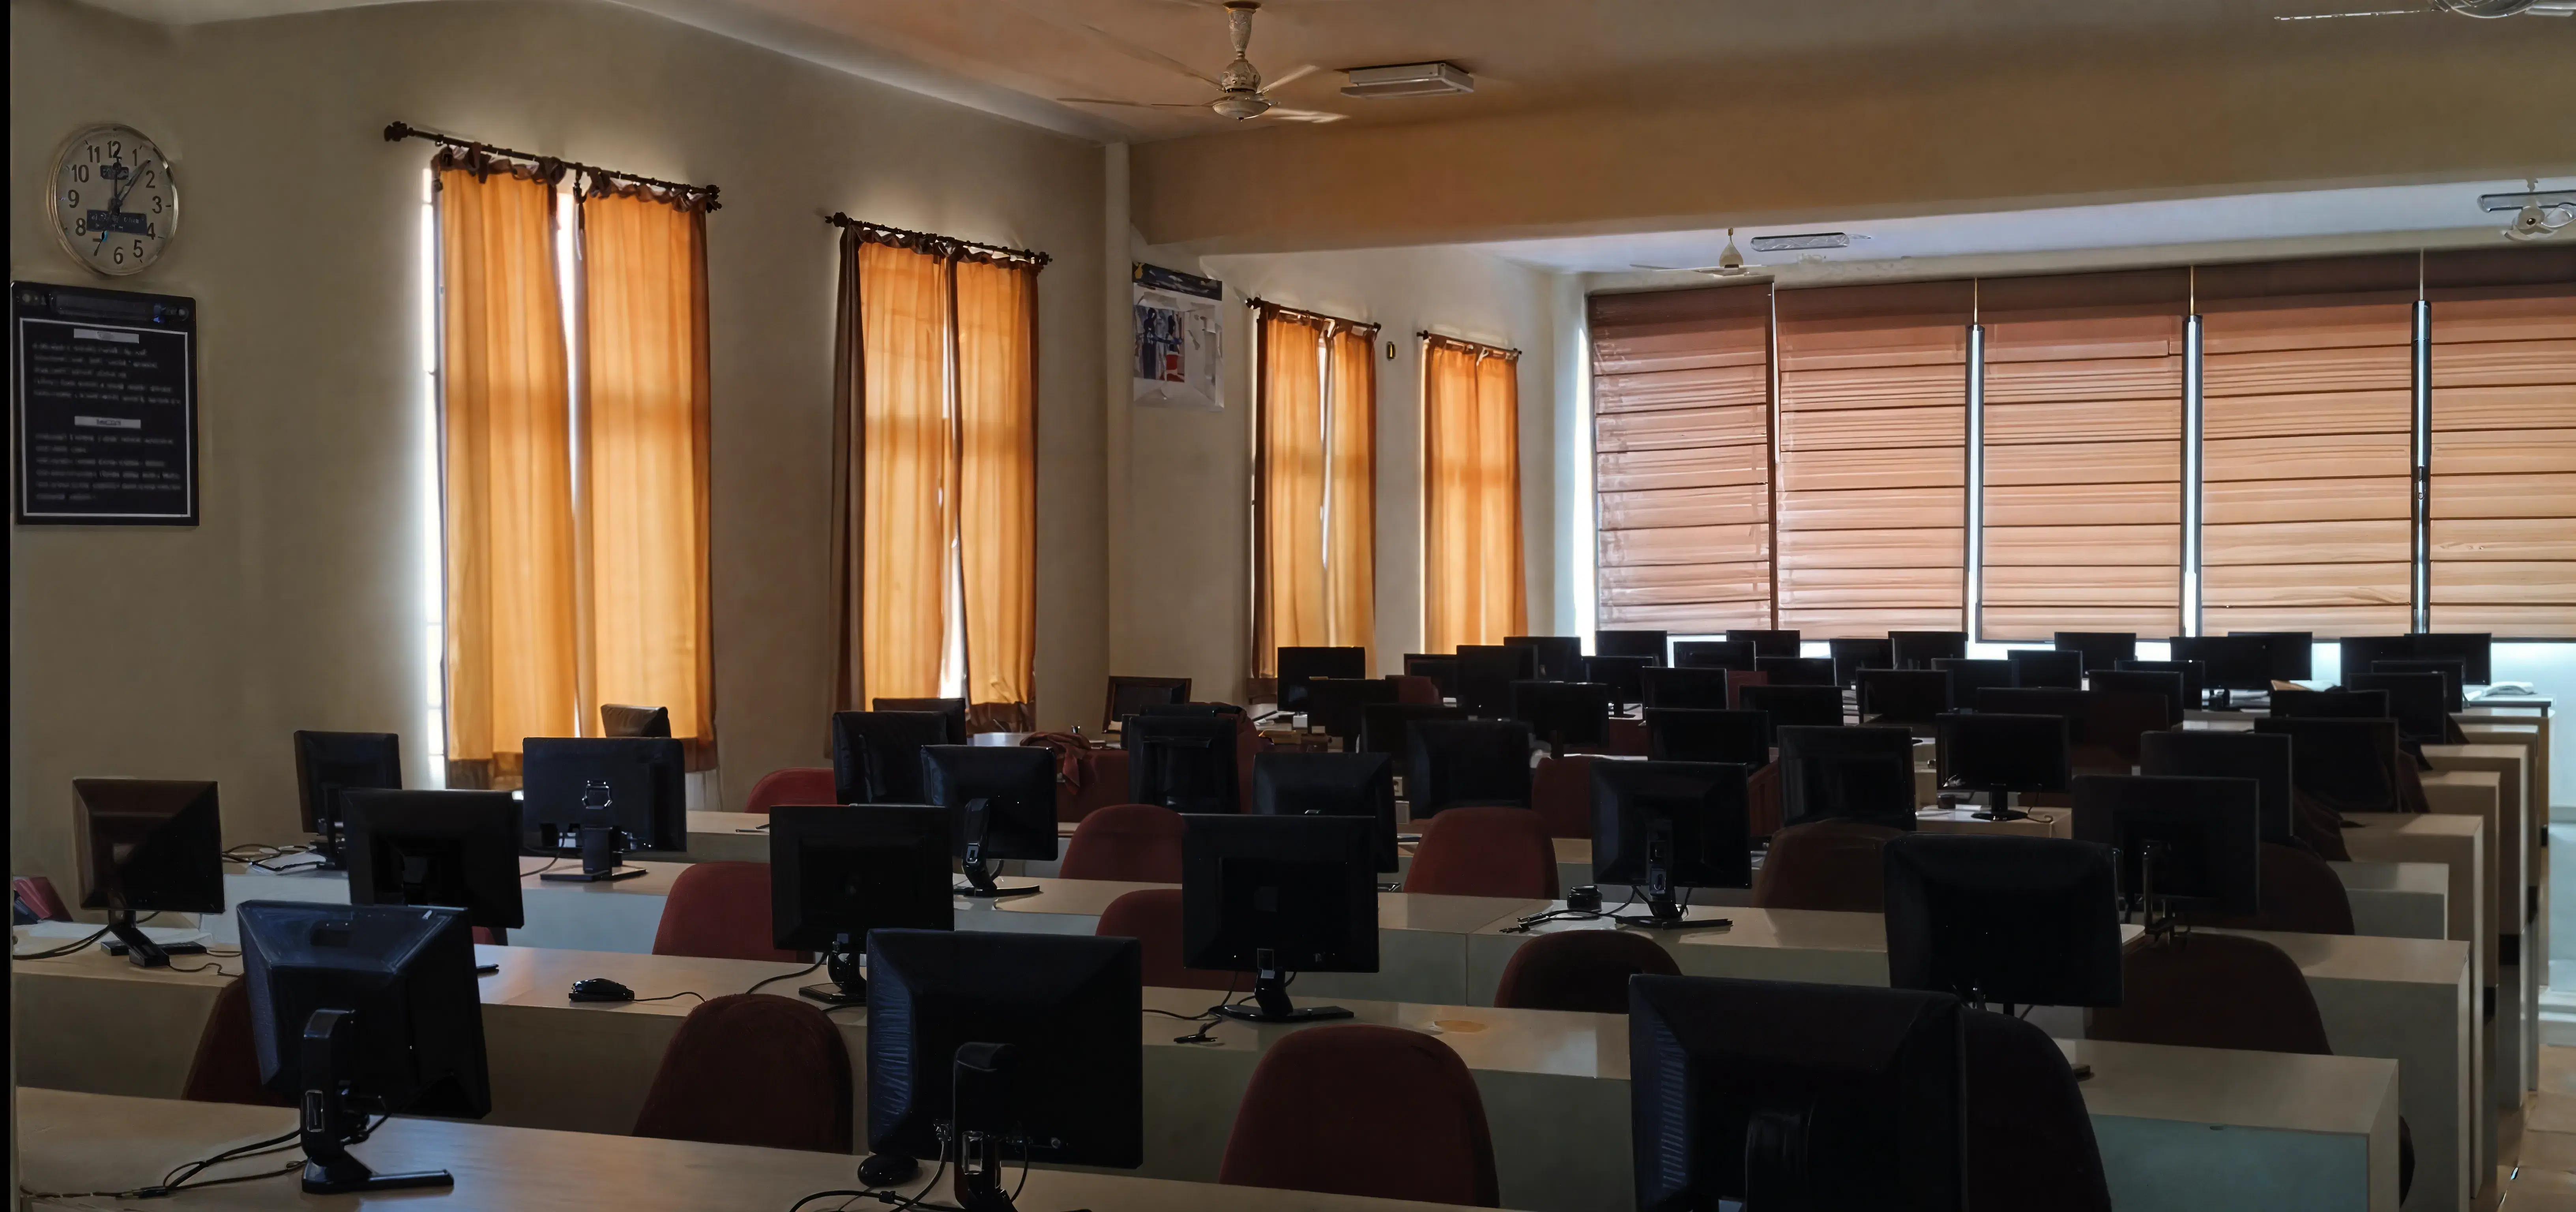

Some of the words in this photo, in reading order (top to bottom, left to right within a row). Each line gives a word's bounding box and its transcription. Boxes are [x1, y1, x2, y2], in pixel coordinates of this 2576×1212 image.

[87, 145, 100, 163] 11
[107, 141, 121, 158] 12
[132, 149, 137, 166] 1
[72, 165, 89, 182] 10
[146, 170, 155, 188] 2
[68, 190, 79, 208] 9
[152, 196, 162, 213] 3
[75, 218, 86, 236] 8
[147, 223, 155, 240] 4
[93, 238, 103, 256] 7
[114, 247, 123, 264] 6
[133, 239, 143, 258] 5
